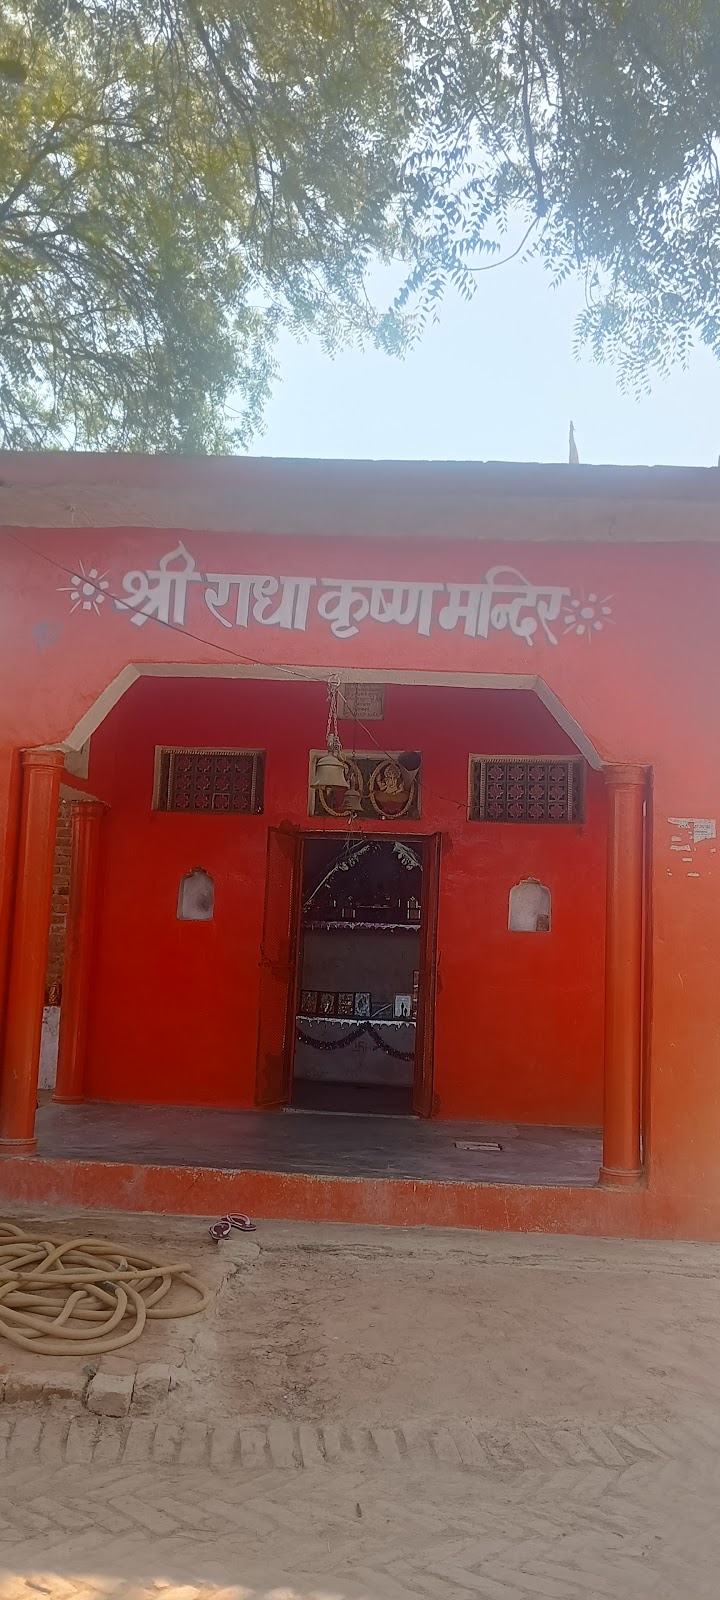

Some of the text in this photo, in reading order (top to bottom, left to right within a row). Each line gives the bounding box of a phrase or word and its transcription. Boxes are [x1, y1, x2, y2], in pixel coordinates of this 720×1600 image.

[114, 541, 570, 646] श्री राधा कृष्ण मन्दिर
